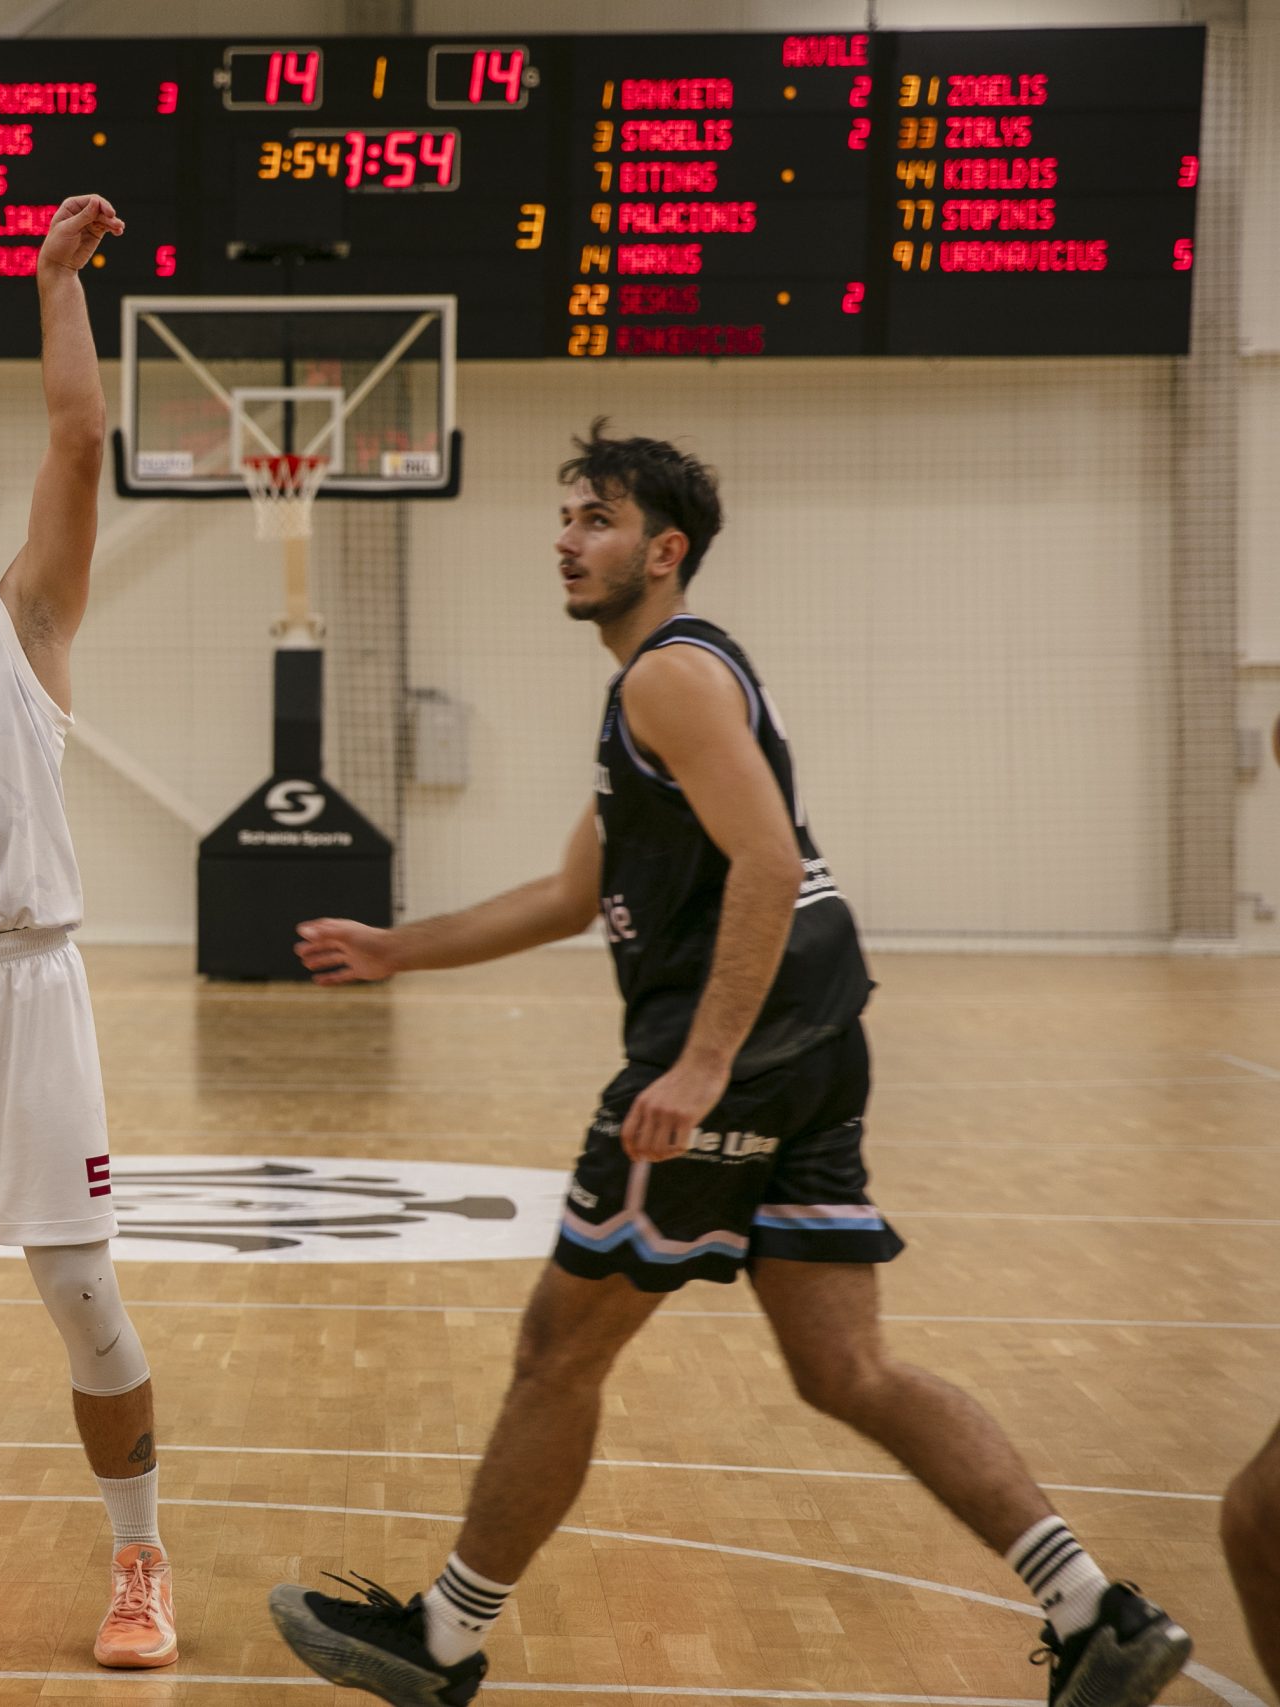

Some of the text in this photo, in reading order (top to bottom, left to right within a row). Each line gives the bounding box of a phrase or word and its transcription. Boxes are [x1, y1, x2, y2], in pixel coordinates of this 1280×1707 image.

[265, 51, 320, 106] 14
[372, 57, 388, 100] 1
[468, 49, 524, 104] 14
[601, 82, 615, 109] 1
[848, 75, 872, 108] 2
[899, 75, 940, 107] 31
[157, 82, 178, 114] 3
[594, 121, 614, 153] 3
[848, 118, 871, 150] 2
[901, 117, 938, 149] 33
[258, 141, 340, 179] 3:54
[596, 161, 613, 192] 7
[896, 162, 936, 189] 44
[1177, 156, 1200, 188] 3
[516, 204, 546, 250] 3
[590, 203, 612, 232] 9
[899, 199, 935, 230] 77
[155, 245, 176, 277] 5
[580, 247, 611, 273] 14
[892, 240, 933, 271] 91
[1172, 238, 1194, 270] 5
[568, 284, 610, 316] 22
[841, 282, 865, 314] 2
[568, 325, 609, 356] 23
